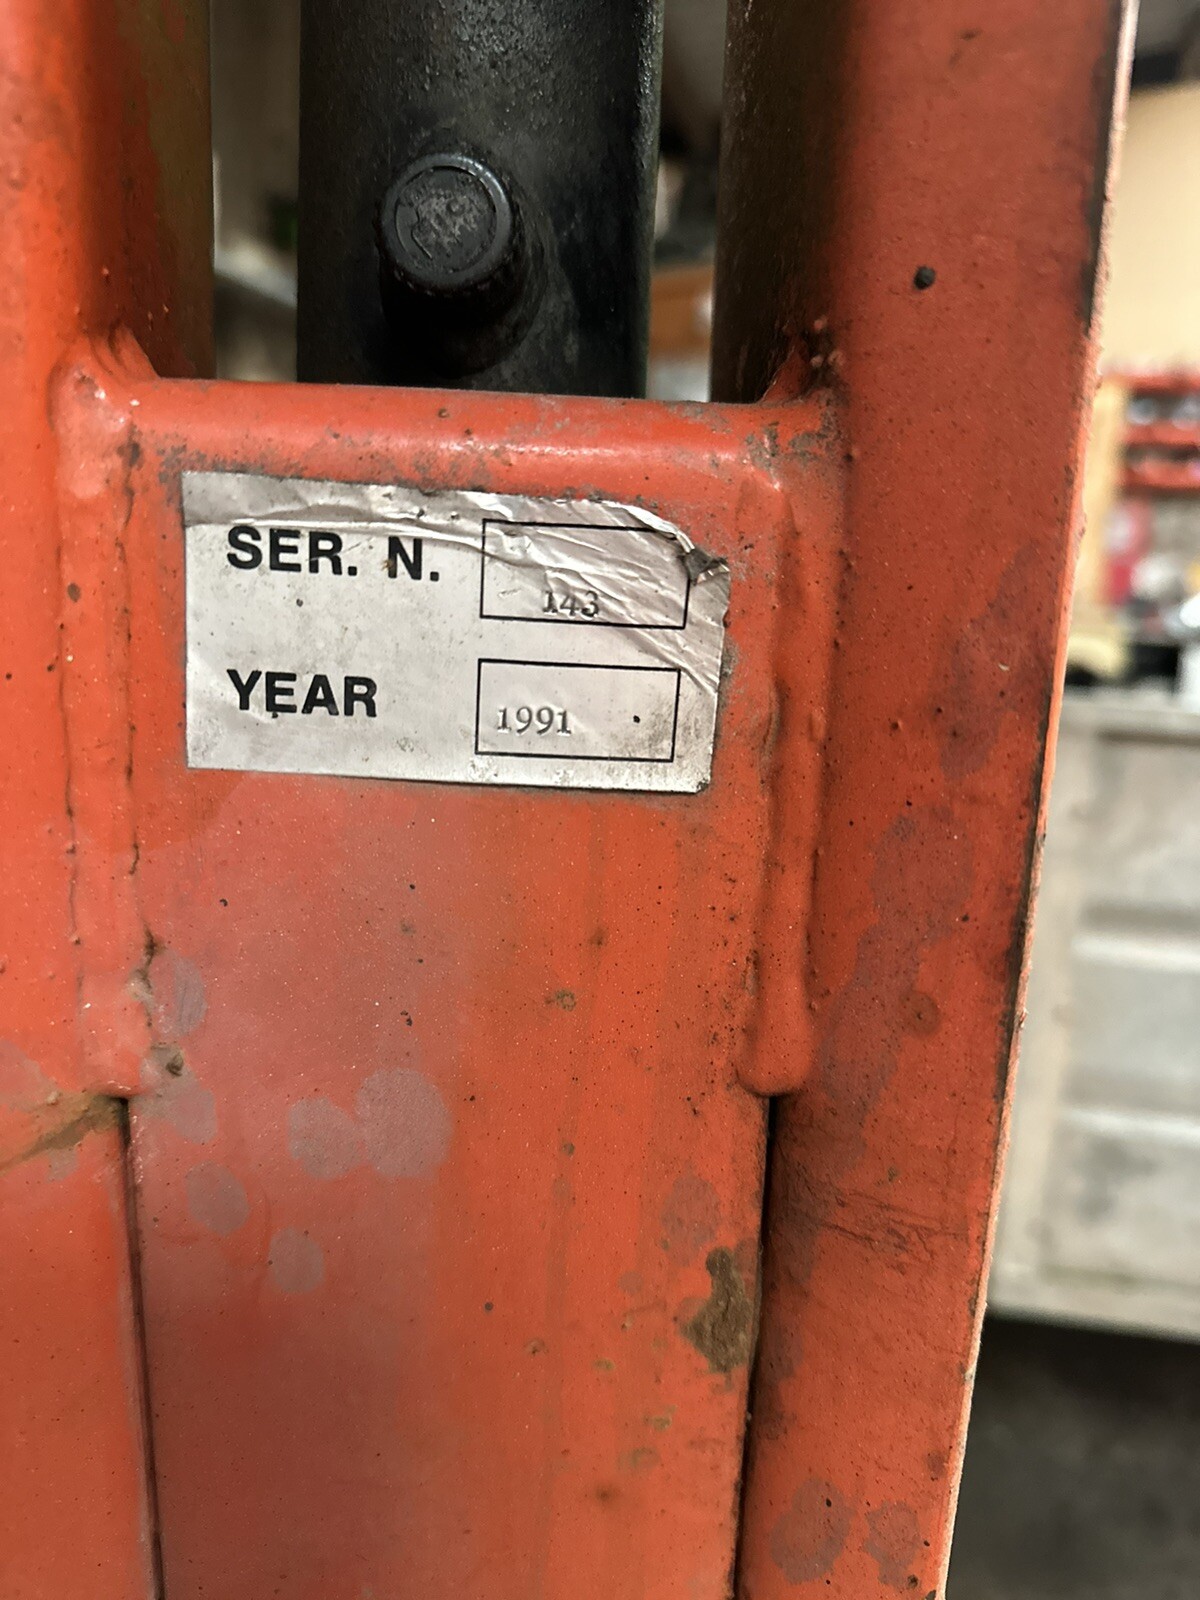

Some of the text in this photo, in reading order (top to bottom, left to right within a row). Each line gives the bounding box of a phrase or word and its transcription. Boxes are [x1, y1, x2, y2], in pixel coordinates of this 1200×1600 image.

[226, 525, 440, 582] SER. N.
[541, 590, 600, 619] 143
[226, 669, 378, 718] YEAR
[496, 706, 573, 737] 1991
